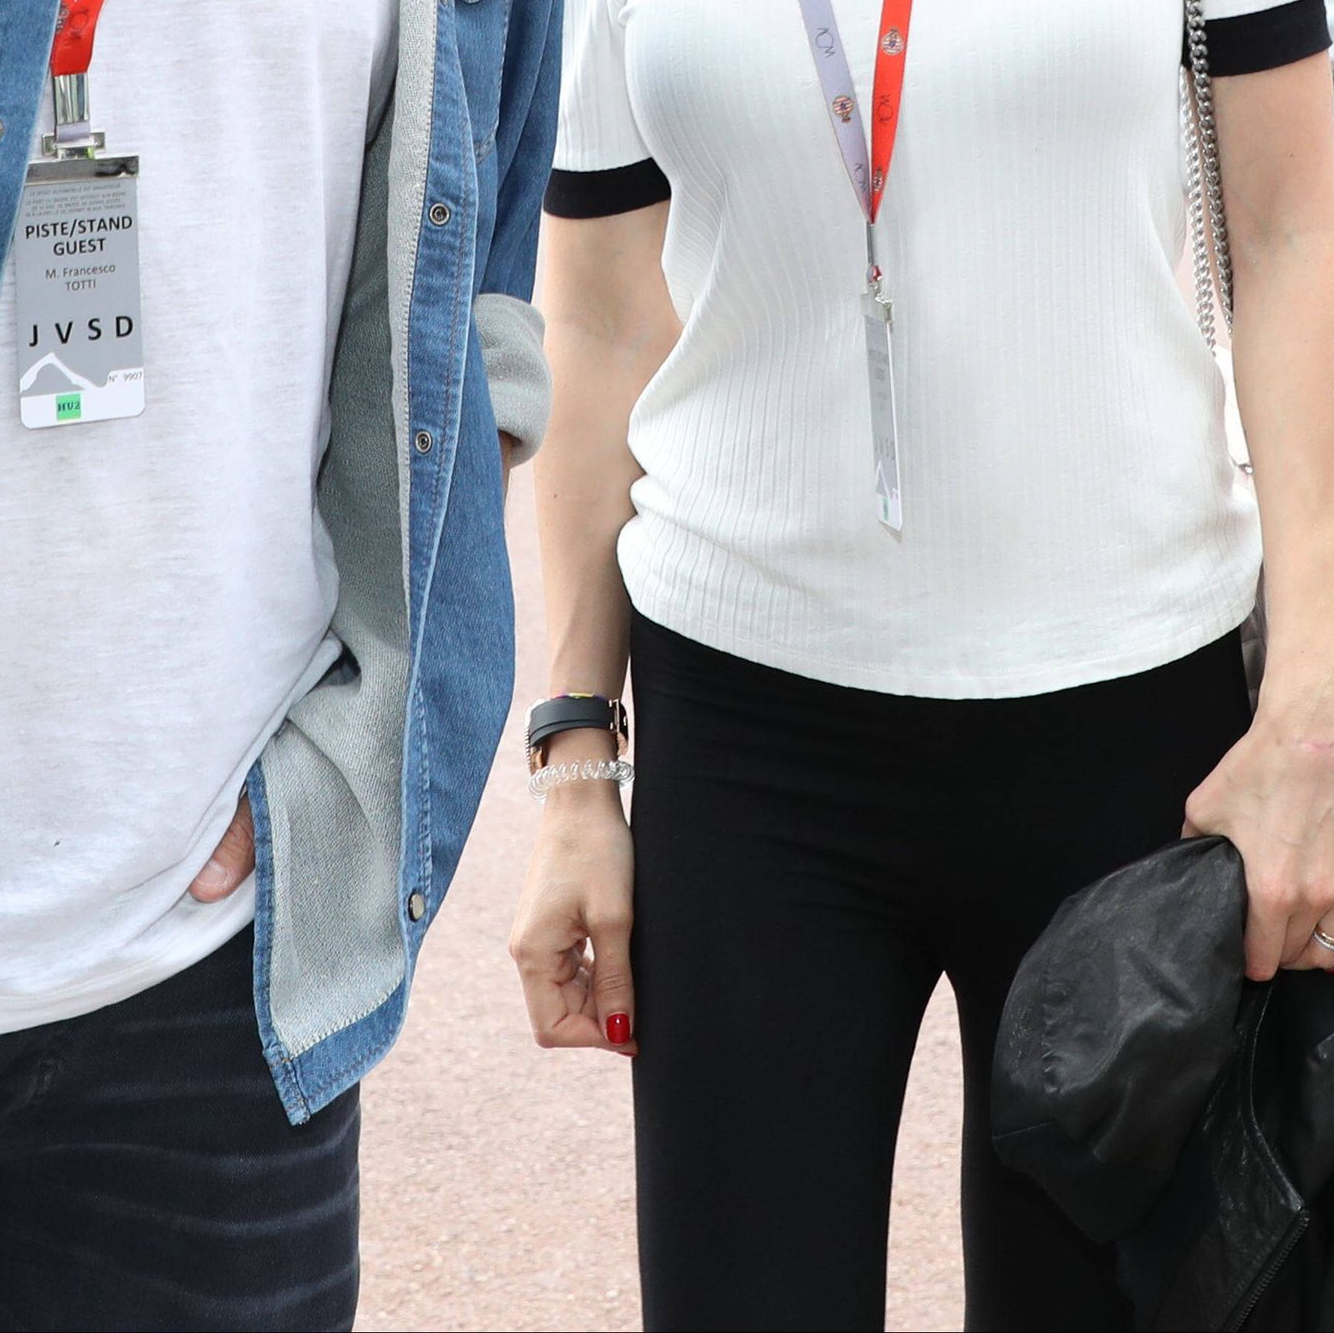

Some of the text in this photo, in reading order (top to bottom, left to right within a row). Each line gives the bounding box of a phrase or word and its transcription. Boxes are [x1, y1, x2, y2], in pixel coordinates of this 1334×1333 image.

[25, 215, 133, 239] PISTE/STAND
[53, 237, 107, 256] GUEST
[45, 263, 117, 279] M. Francesco
[65, 279, 97, 292] TOTTI
[29, 315, 134, 348] J V S D
